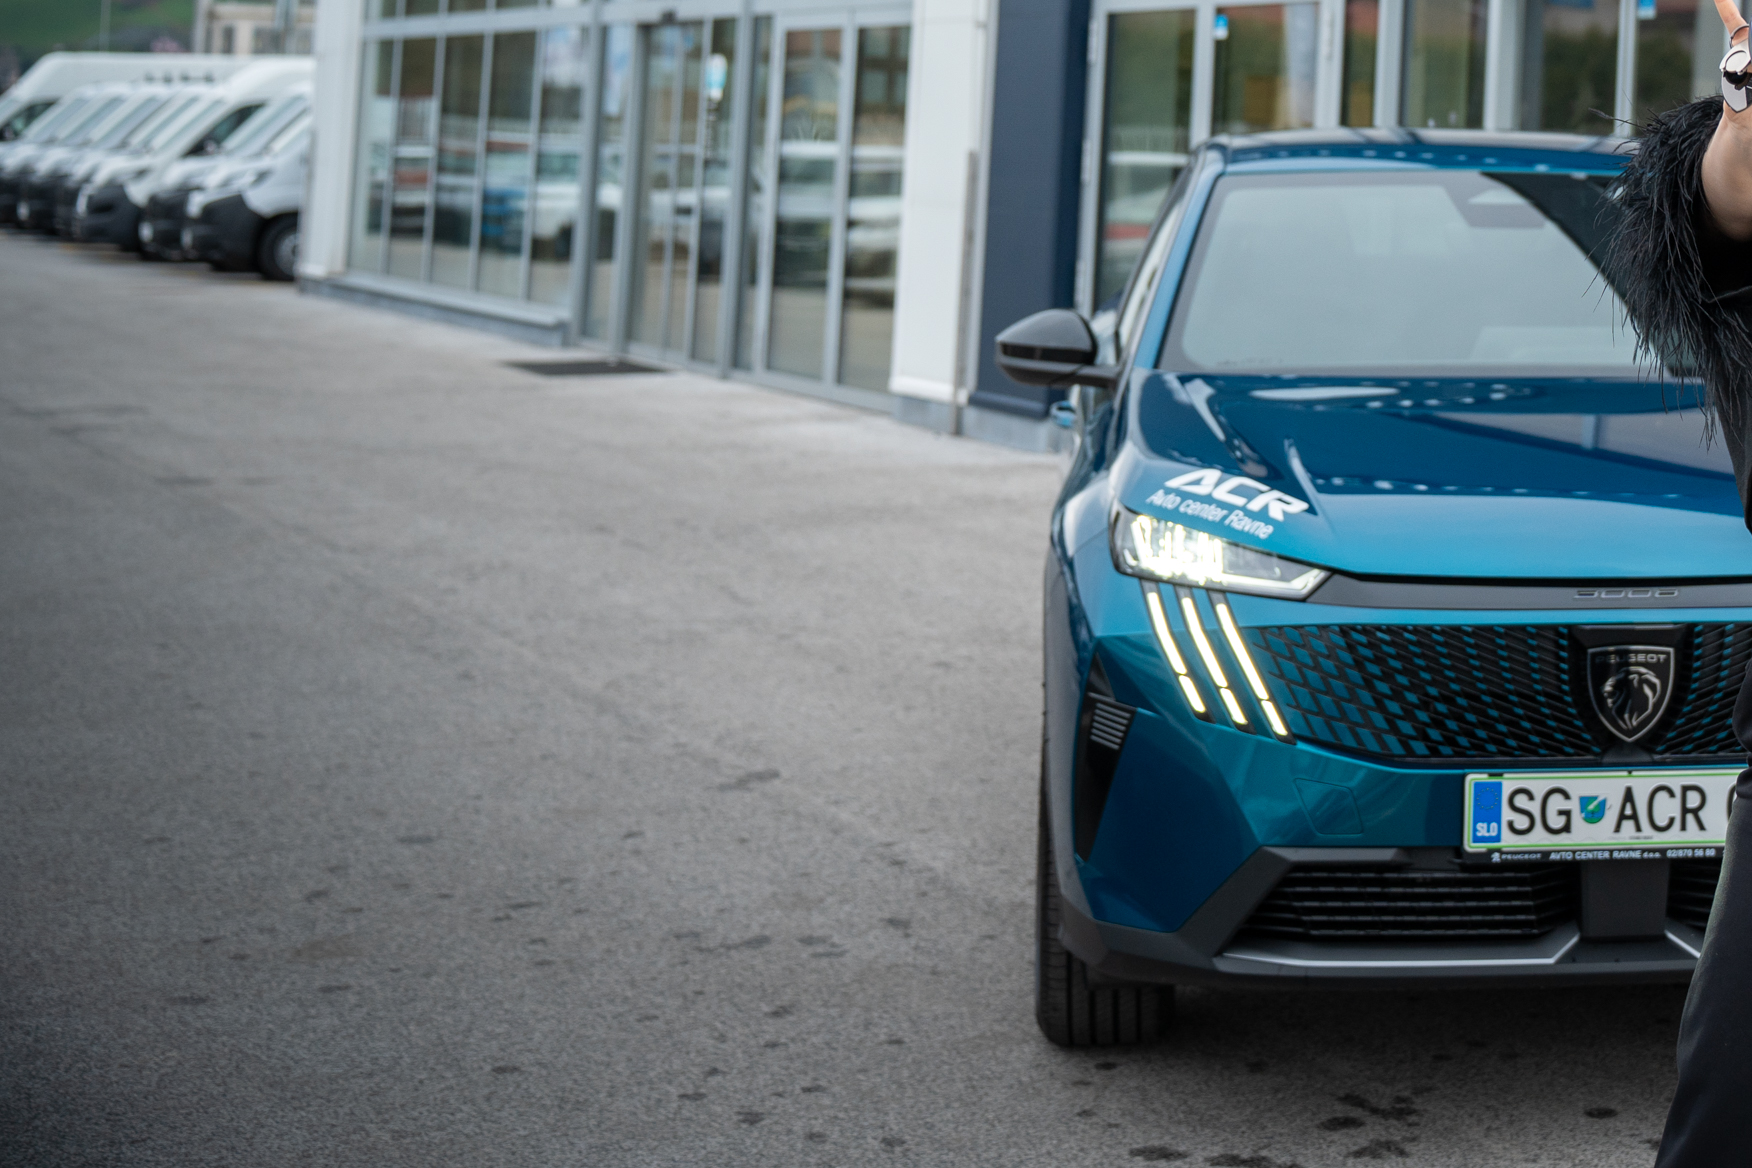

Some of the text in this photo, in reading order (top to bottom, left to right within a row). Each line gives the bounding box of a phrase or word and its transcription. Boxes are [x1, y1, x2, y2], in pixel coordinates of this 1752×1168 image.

[1163, 468, 1310, 522] ACR
[1145, 488, 1274, 540] Avto center Ravne
[1595, 653, 1668, 664] PEUGEOT
[1505, 785, 1573, 836] SG
[1612, 783, 1707, 833] ACR
[1475, 821, 1499, 837] SLO
[1501, 852, 1542, 860] PEUGEOT
[1549, 850, 1573, 860] AVTO
[1574, 850, 1610, 860] CENTER
[1612, 849, 1642, 859] RAVNE
